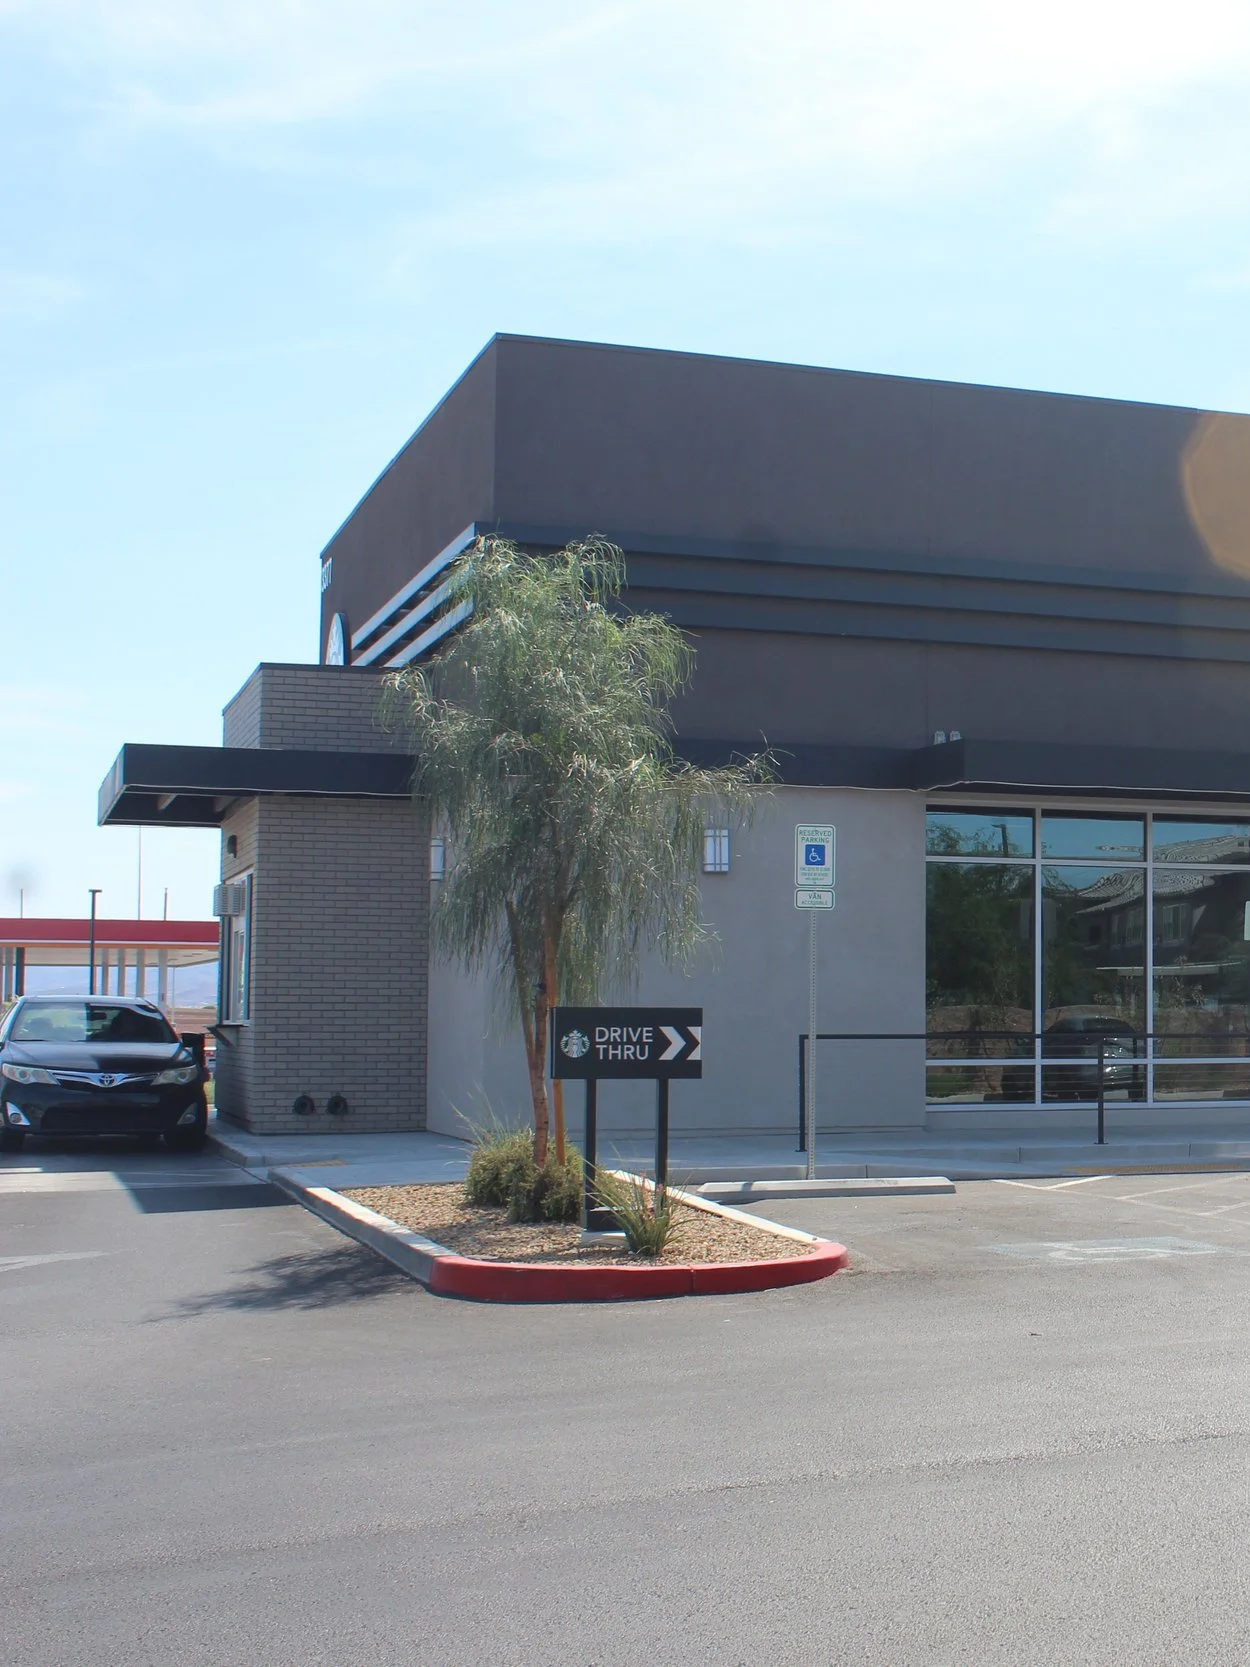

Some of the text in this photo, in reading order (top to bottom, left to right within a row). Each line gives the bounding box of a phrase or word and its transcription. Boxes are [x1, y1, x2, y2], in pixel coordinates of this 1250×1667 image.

[799, 829, 832, 837] RESERVED
[808, 892, 822, 900] VAN
[595, 1027, 653, 1043] DRIVE
[596, 1044, 649, 1060] THRU
